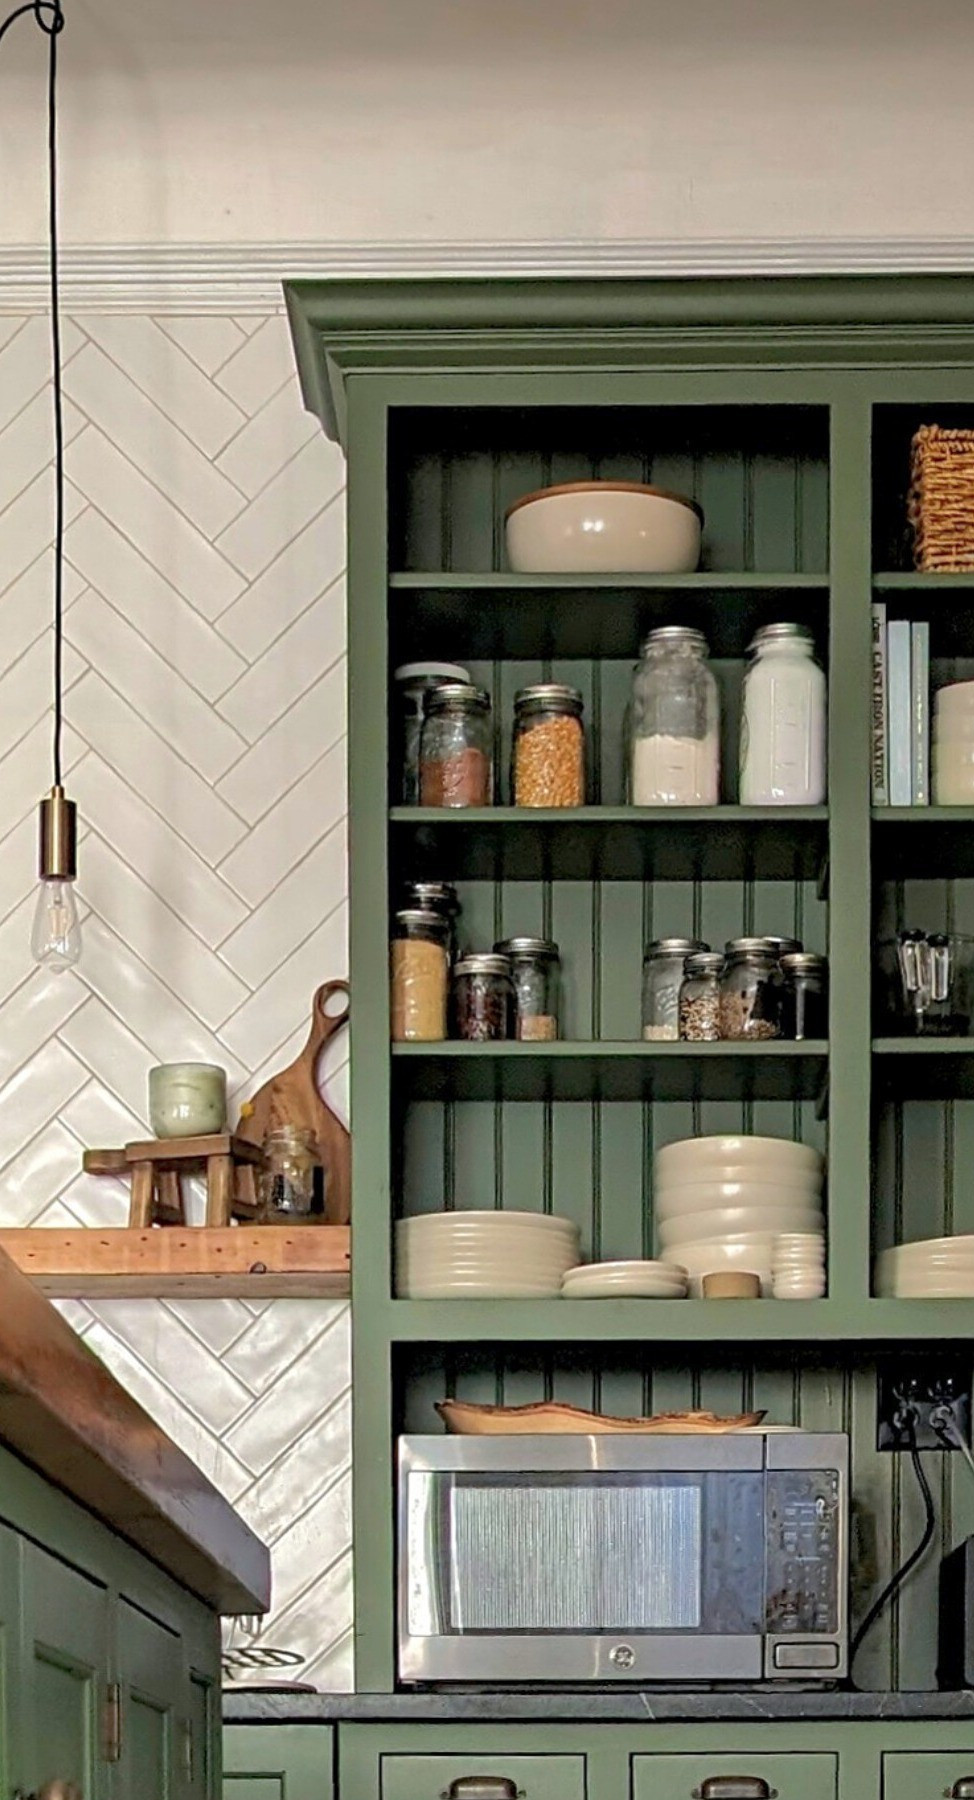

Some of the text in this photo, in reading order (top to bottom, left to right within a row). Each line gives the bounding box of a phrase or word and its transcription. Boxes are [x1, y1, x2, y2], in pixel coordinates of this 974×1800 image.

[872, 651, 883, 688] CAST
[873, 691, 884, 730] IRON
[873, 733, 885, 788] NATION
